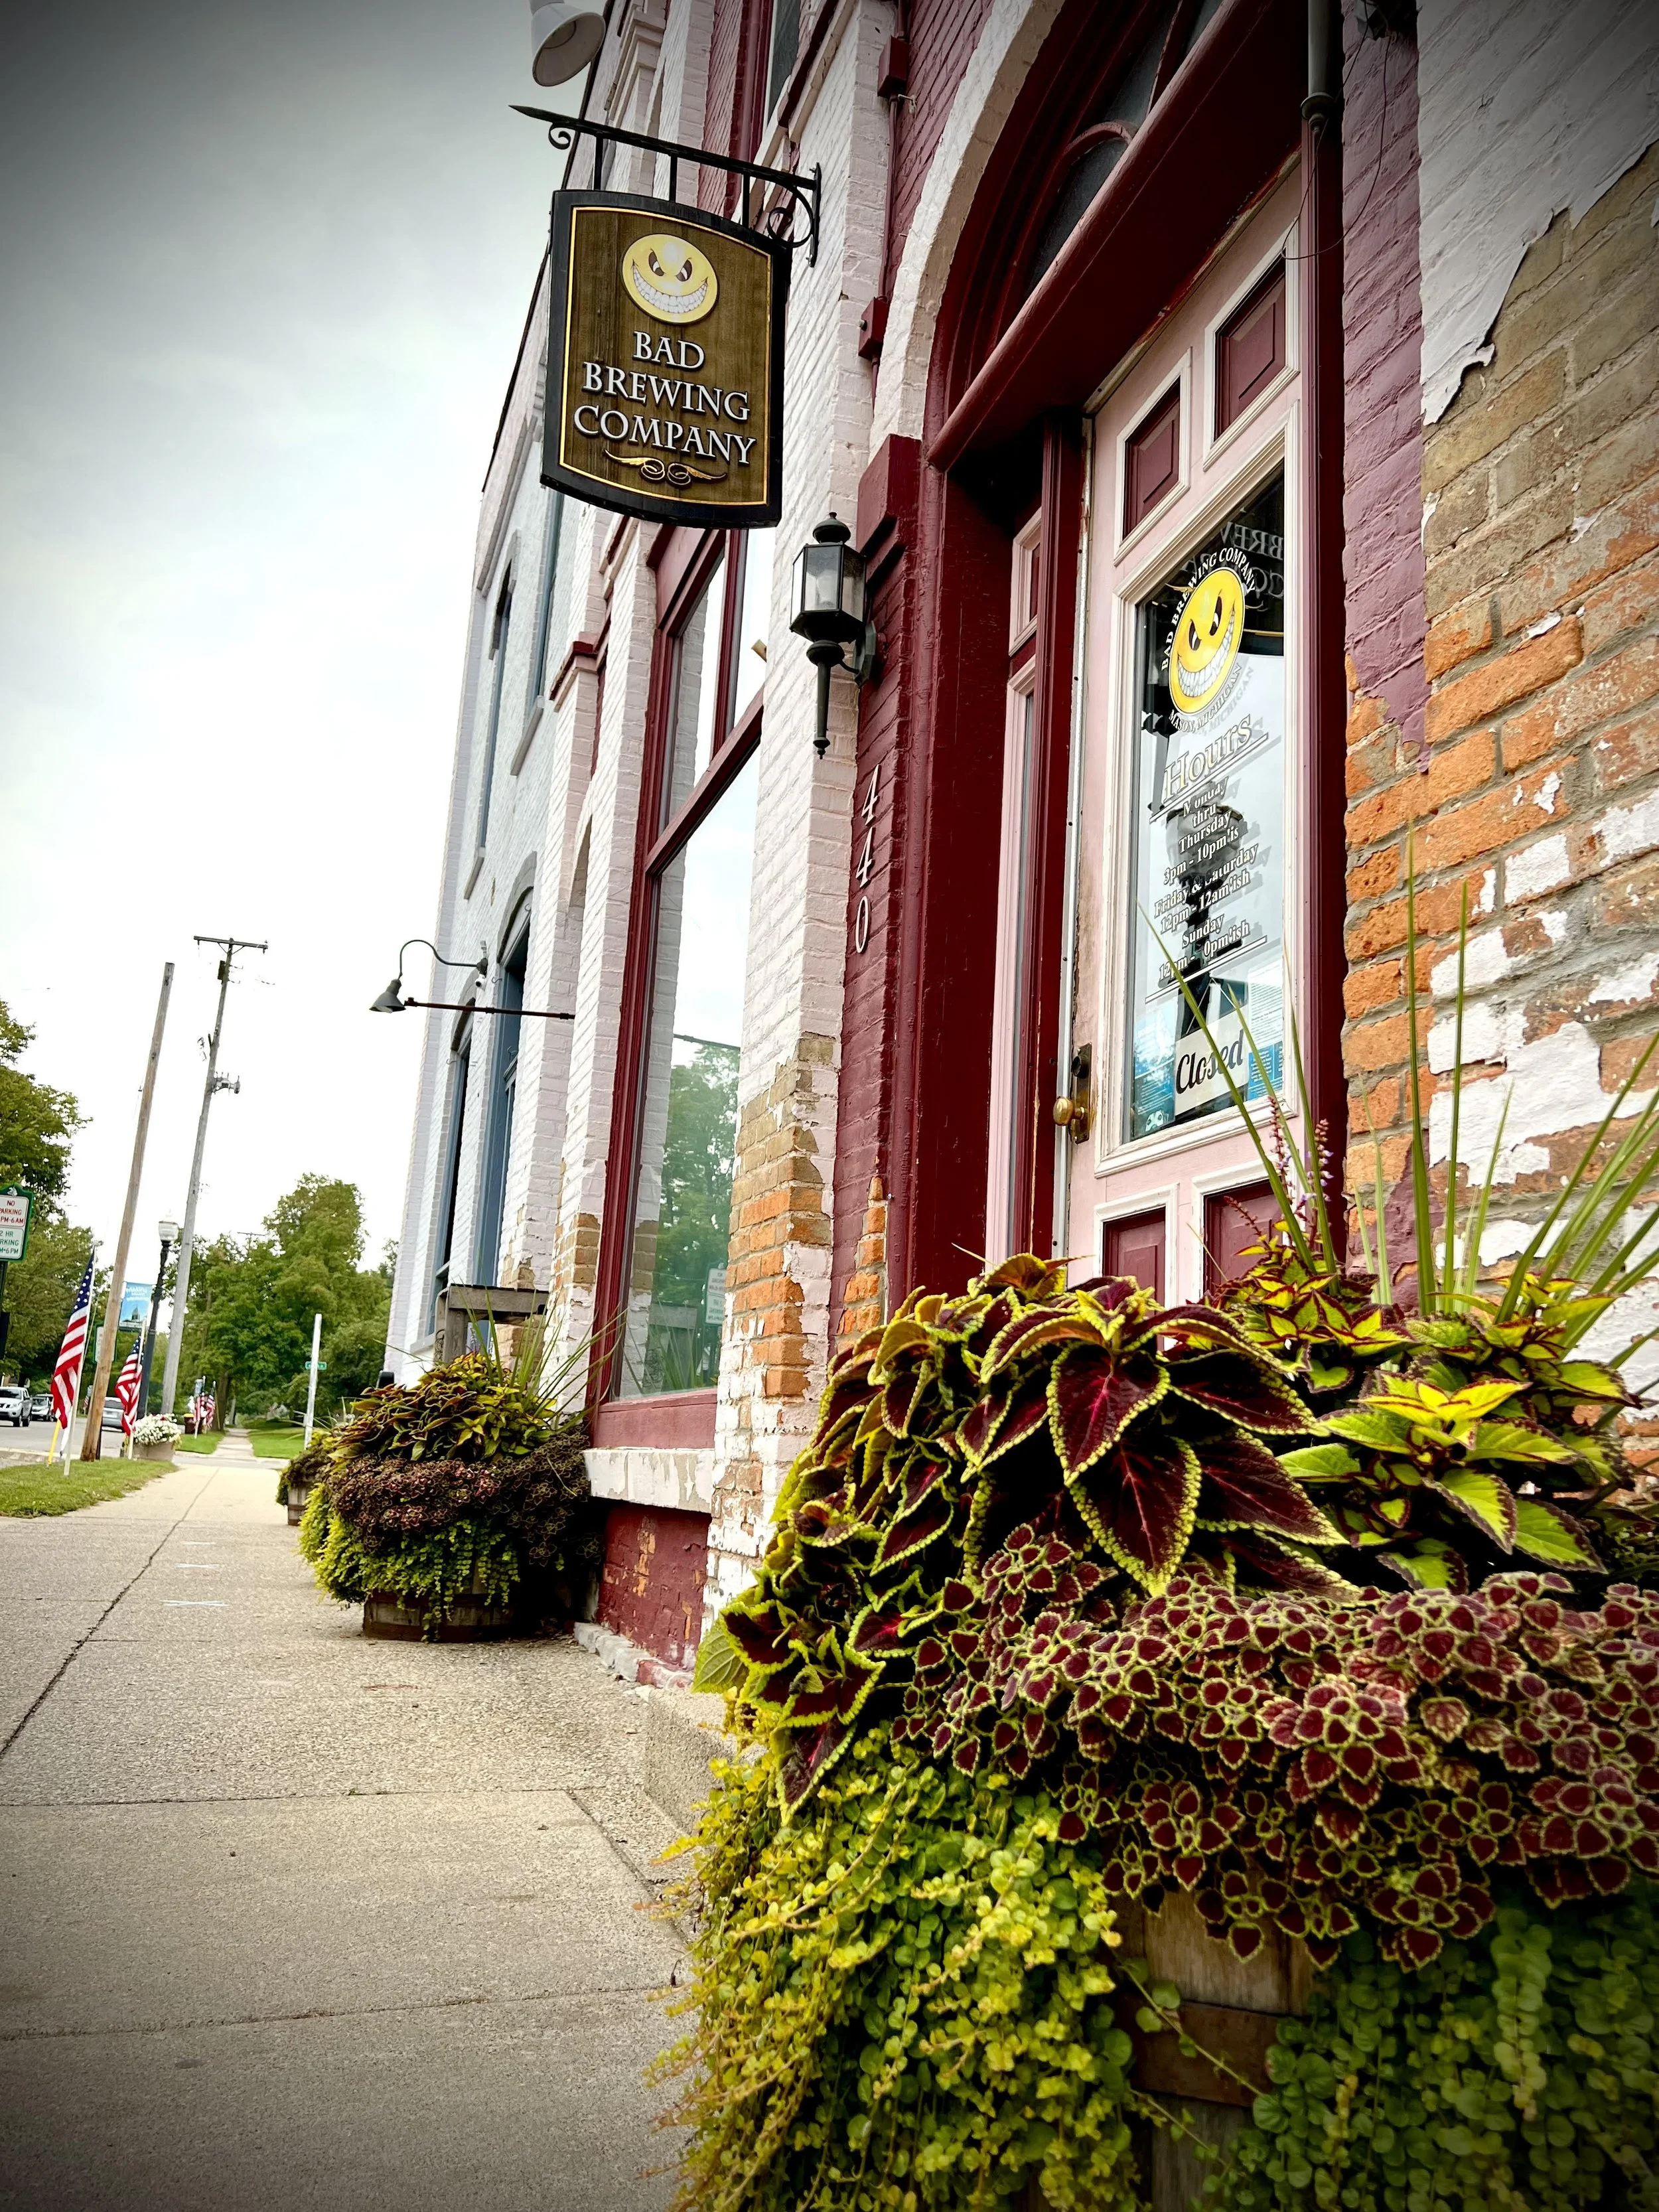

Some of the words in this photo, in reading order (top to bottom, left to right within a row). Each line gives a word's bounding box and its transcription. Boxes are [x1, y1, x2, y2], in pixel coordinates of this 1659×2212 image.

[632, 331, 705, 370] BAD
[582, 361, 751, 422] BREWING
[573, 405, 757, 465] COMPANY
[1161, 631, 1174, 671] BAD
[1171, 552, 1218, 627] BREWING
[1219, 548, 1256, 595] COMPANY
[1169, 709, 1196, 733] MASON,
[1197, 662, 1242, 730] MICHIGAN
[1163, 713, 1252, 802] Hours
[1179, 810, 1232, 855] Thursday
[1192, 803, 1216, 828] thru
[855, 763, 881, 954] 440
[1163, 867, 1187, 886] 3pm
[1196, 825, 1242, 864] 10pm'is
[1154, 888, 1189, 919] Friday
[1161, 907, 1190, 935] 12pm
[1182, 913, 1225, 950] Sunday
[1203, 919, 1251, 958] 0pm'ish
[1175, 1028, 1244, 1094] Closed
